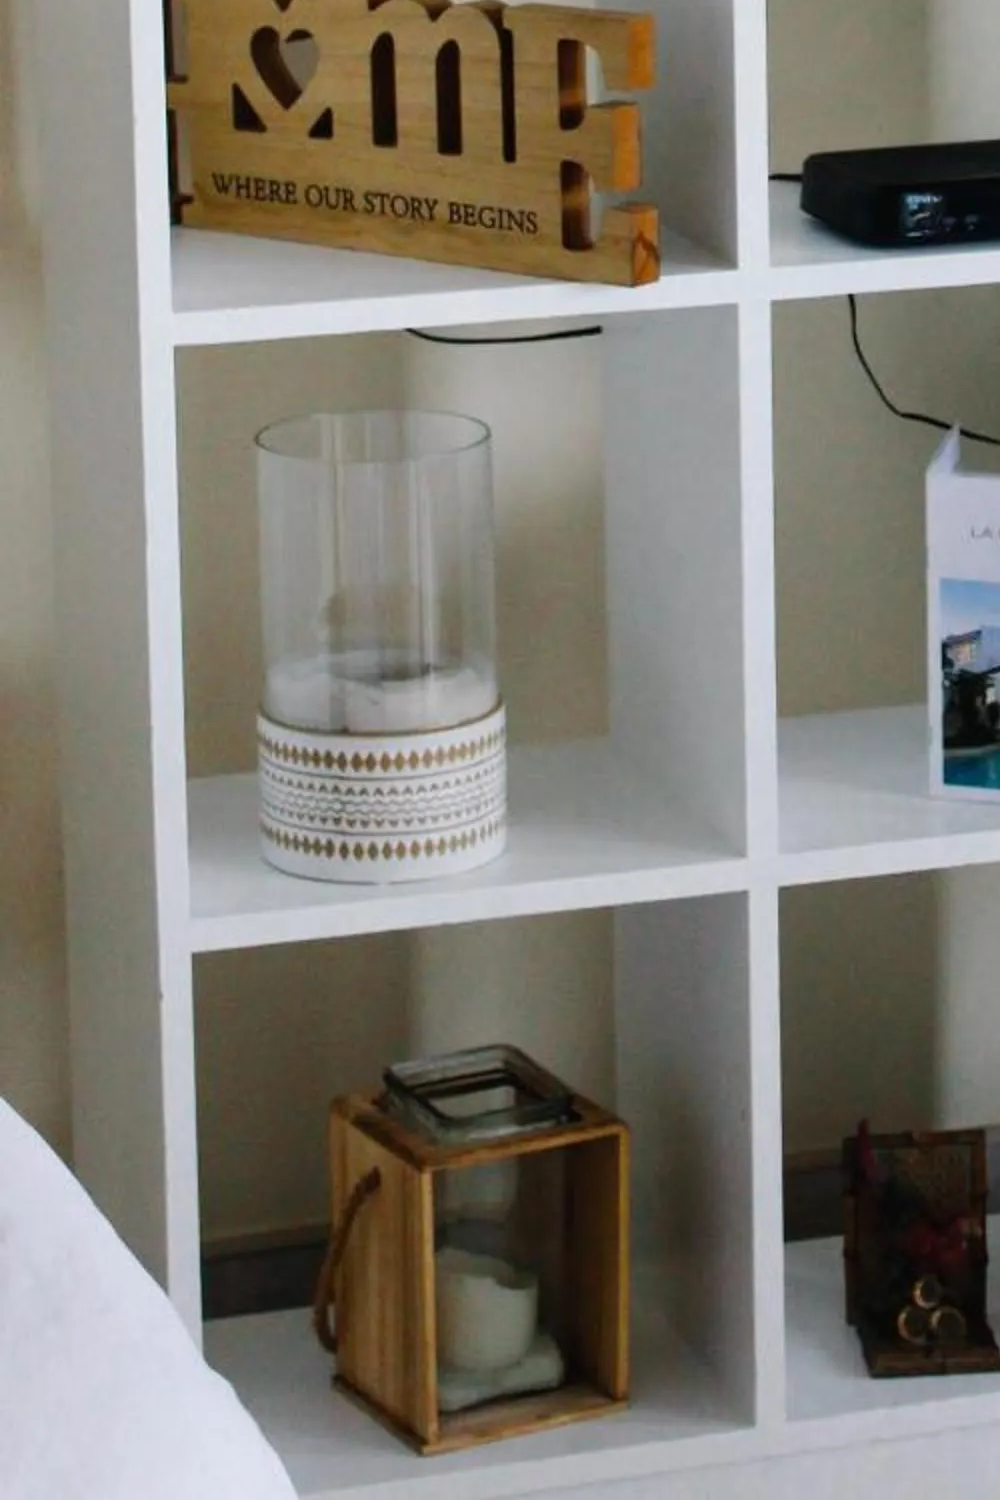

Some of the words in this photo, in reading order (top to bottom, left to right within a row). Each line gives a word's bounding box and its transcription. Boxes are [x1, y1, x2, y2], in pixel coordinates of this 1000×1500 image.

[211, 171, 298, 206] WHERE
[304, 184, 358, 213] OUR
[363, 190, 440, 222] STORY
[448, 201, 539, 235] BEGINS
[971, 526, 994, 540] LA
